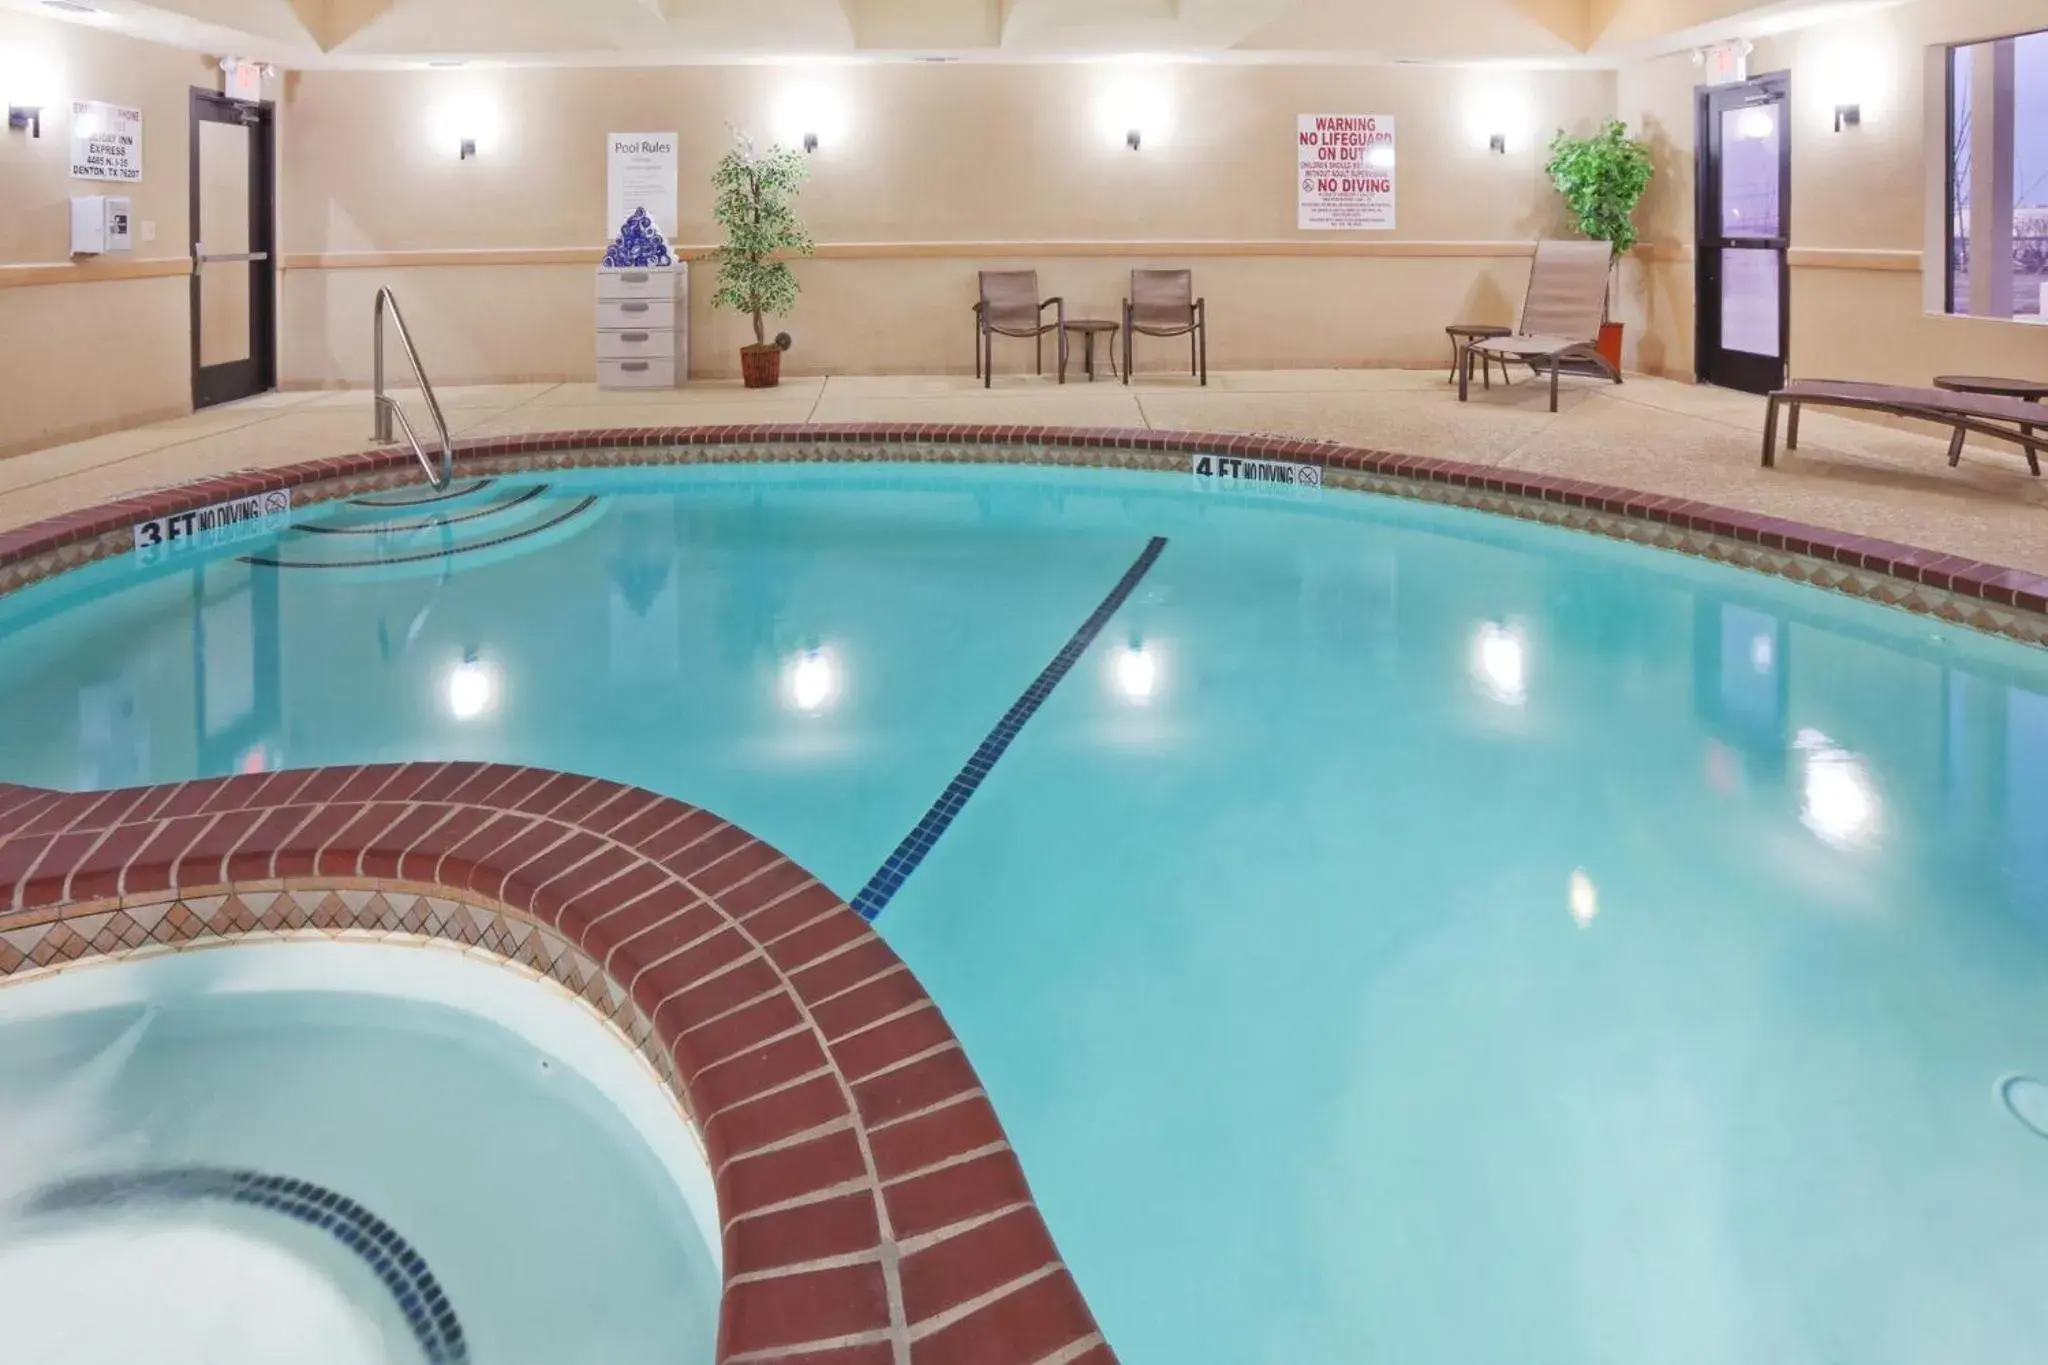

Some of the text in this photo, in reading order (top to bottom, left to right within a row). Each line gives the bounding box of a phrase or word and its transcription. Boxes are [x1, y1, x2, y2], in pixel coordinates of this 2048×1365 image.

[1315, 117, 1376, 132] WARNING
[1299, 131, 1318, 145] NO
[89, 144, 126, 156] EXPRESS
[614, 141, 671, 154] Pool Rules
[1318, 147, 1366, 161] ON DUT
[1318, 178, 1390, 193] NO DIVING
[1196, 457, 1294, 485] 4 FT NO DIVING
[140, 500, 260, 548] 3 FT NO DIVING
